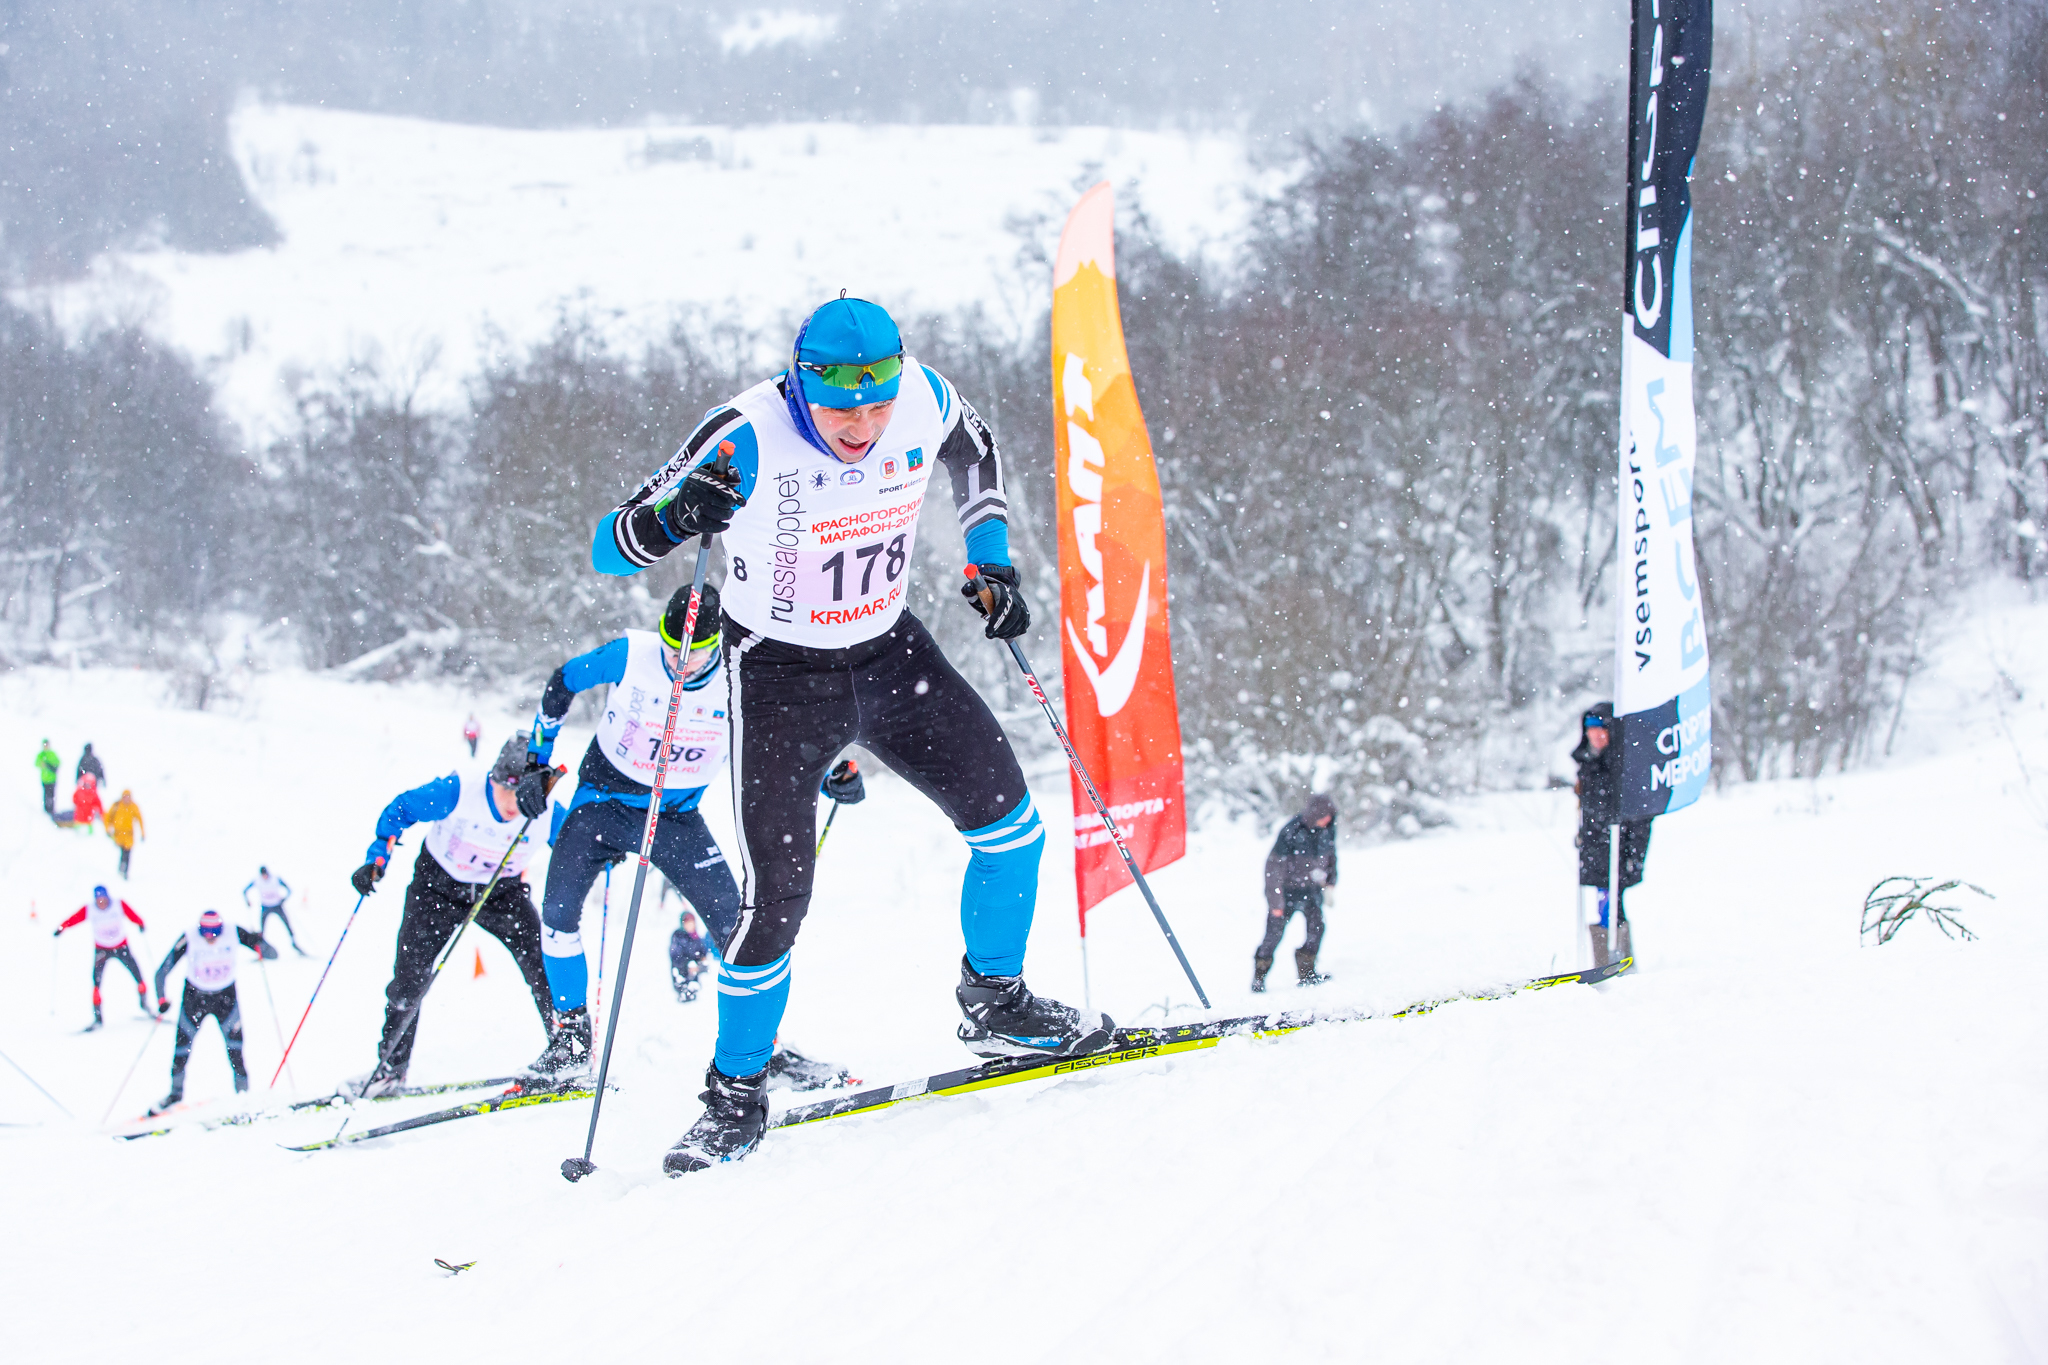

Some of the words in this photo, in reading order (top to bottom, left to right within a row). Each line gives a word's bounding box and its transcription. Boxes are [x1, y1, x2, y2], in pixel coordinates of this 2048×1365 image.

[1634, 0, 1664, 329] СПОР
[767, 468, 807, 623] russialoppet
[822, 533, 907, 601] 178
[810, 578, 902, 625] KRMAR.RU
[655, 665, 688, 788] TEMPESTA
[1103, 797, 1165, 821] ПОРТА
[1053, 1047, 1159, 1074] FISCHER
